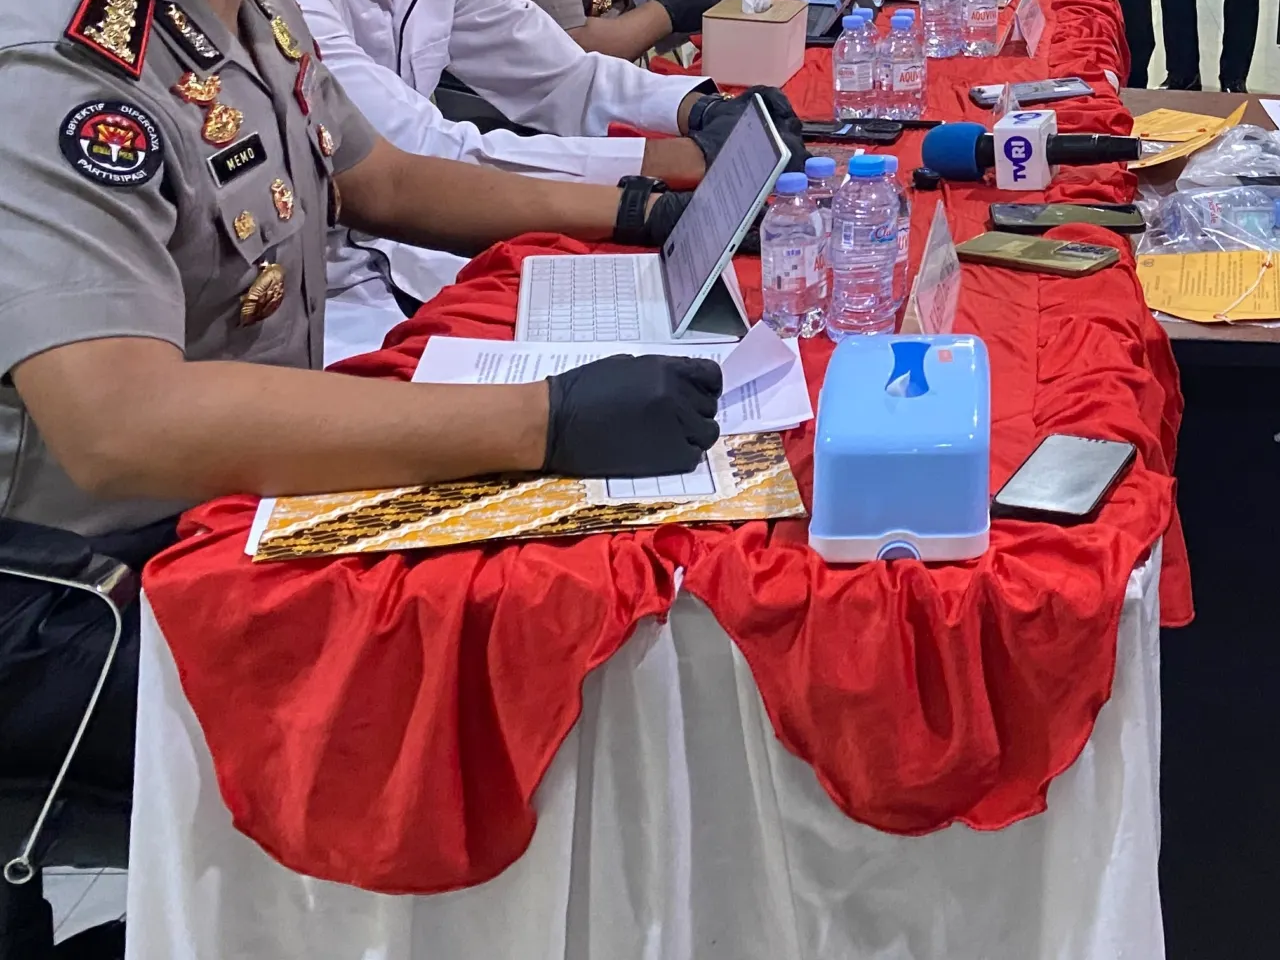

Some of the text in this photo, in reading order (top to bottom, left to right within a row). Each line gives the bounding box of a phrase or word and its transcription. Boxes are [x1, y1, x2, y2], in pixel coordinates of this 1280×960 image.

[66, 103, 105, 136] OBYEKTIF
[120, 105, 159, 152] DIPERCAYA
[77, 158, 148, 182] PARTISIPASI
[226, 147, 255, 171] MEMO
[1009, 138, 1028, 182] TVRI
